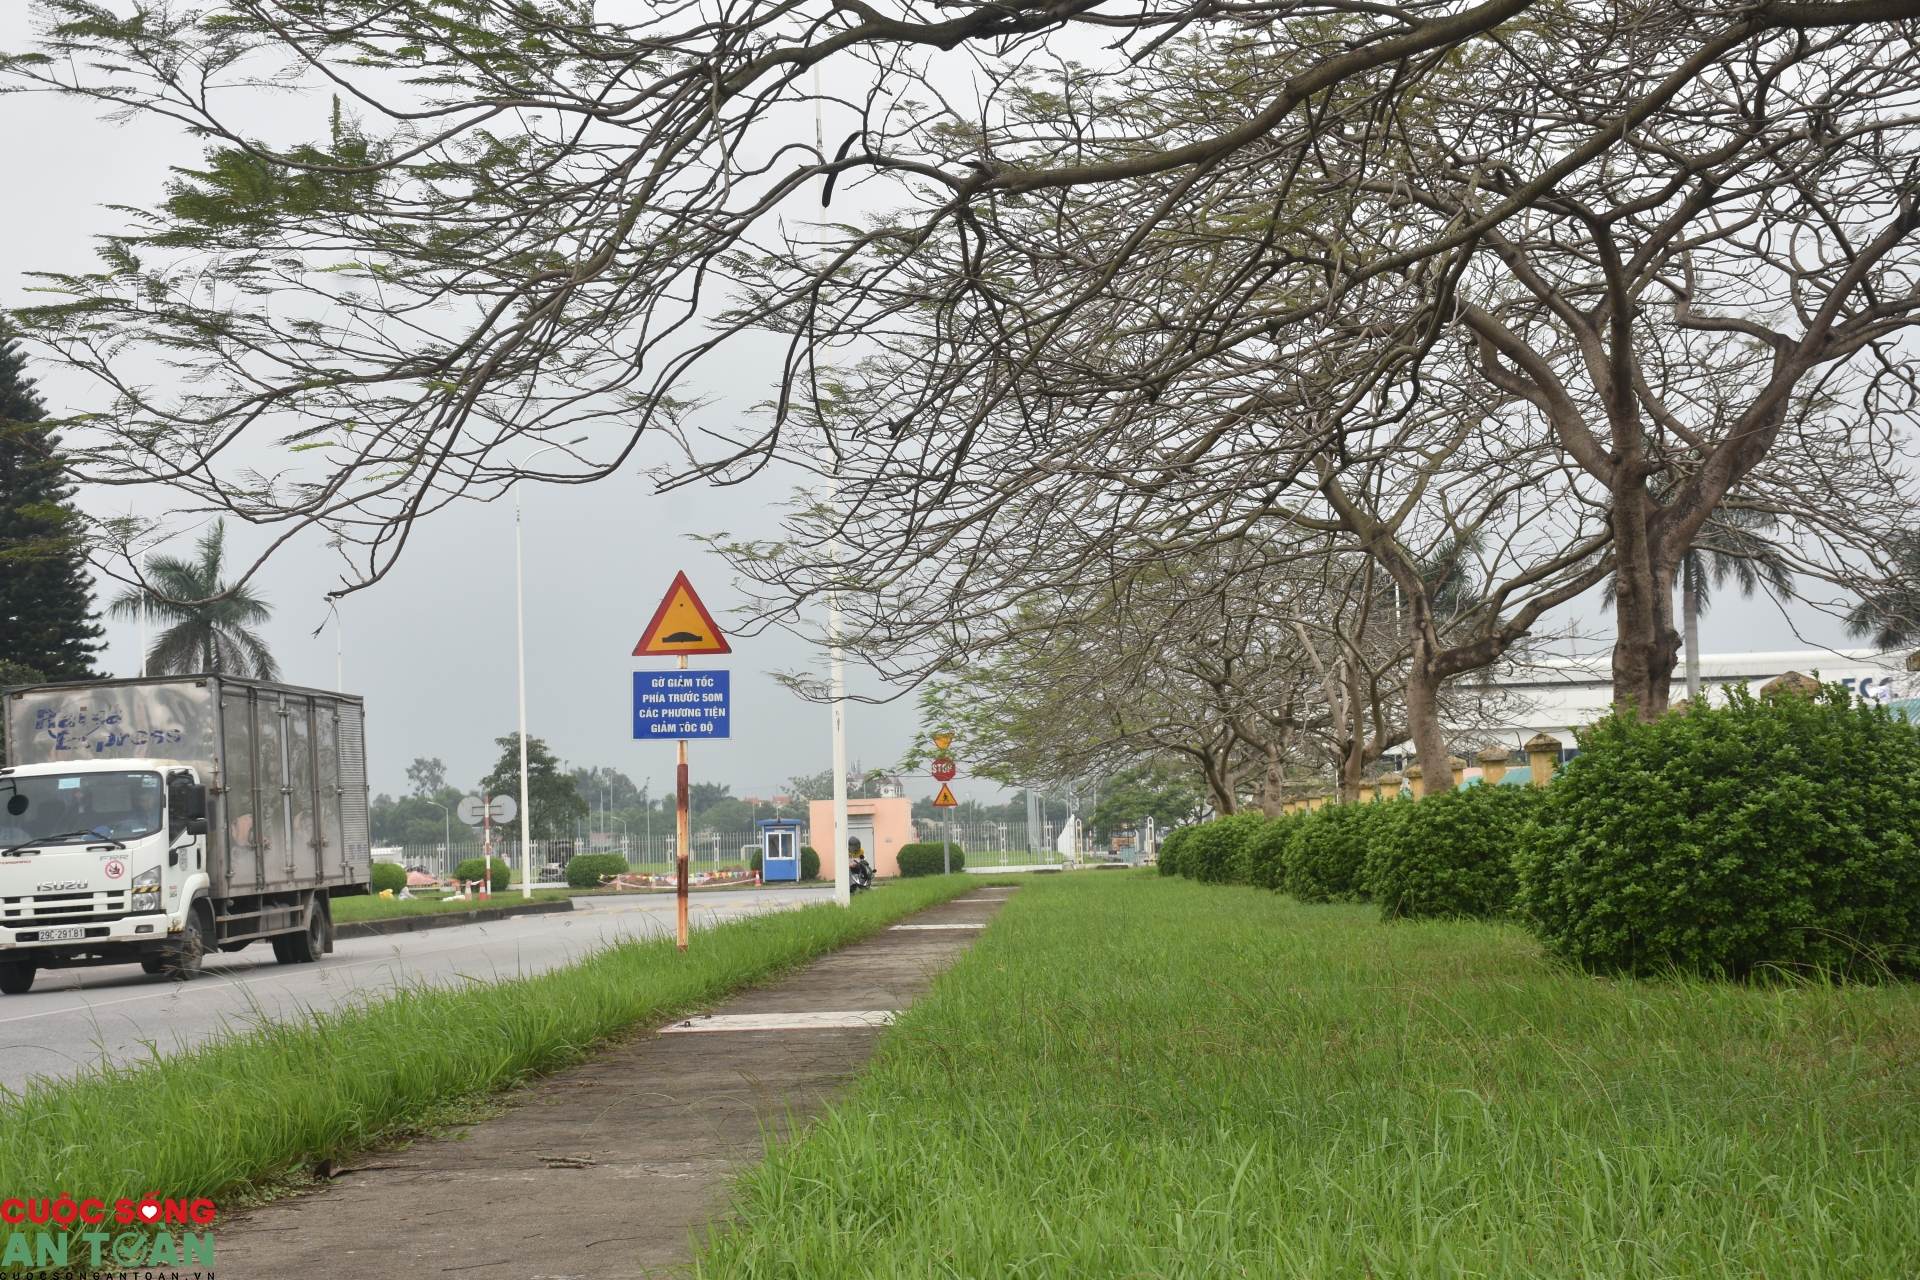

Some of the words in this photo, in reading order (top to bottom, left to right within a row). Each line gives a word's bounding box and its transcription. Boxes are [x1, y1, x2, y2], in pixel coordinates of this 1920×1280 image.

[651, 675, 665, 688] GỜ
[667, 675, 693, 687] GIẢM
[696, 674, 714, 687] TỐC
[642, 691, 666, 703] PHÍA
[668, 690, 700, 703] TRƯỚC
[702, 692, 723, 702] 50M
[639, 706, 659, 718] CÁC
[661, 707, 702, 718] PHƯƠNG
[703, 705, 726, 719] TIỆN
[650, 720, 677, 733] GIẢM
[700, 720, 714, 734] ĐỘ
[932, 763, 953, 774] STOP
[37, 879, 88, 892] ISUZU
